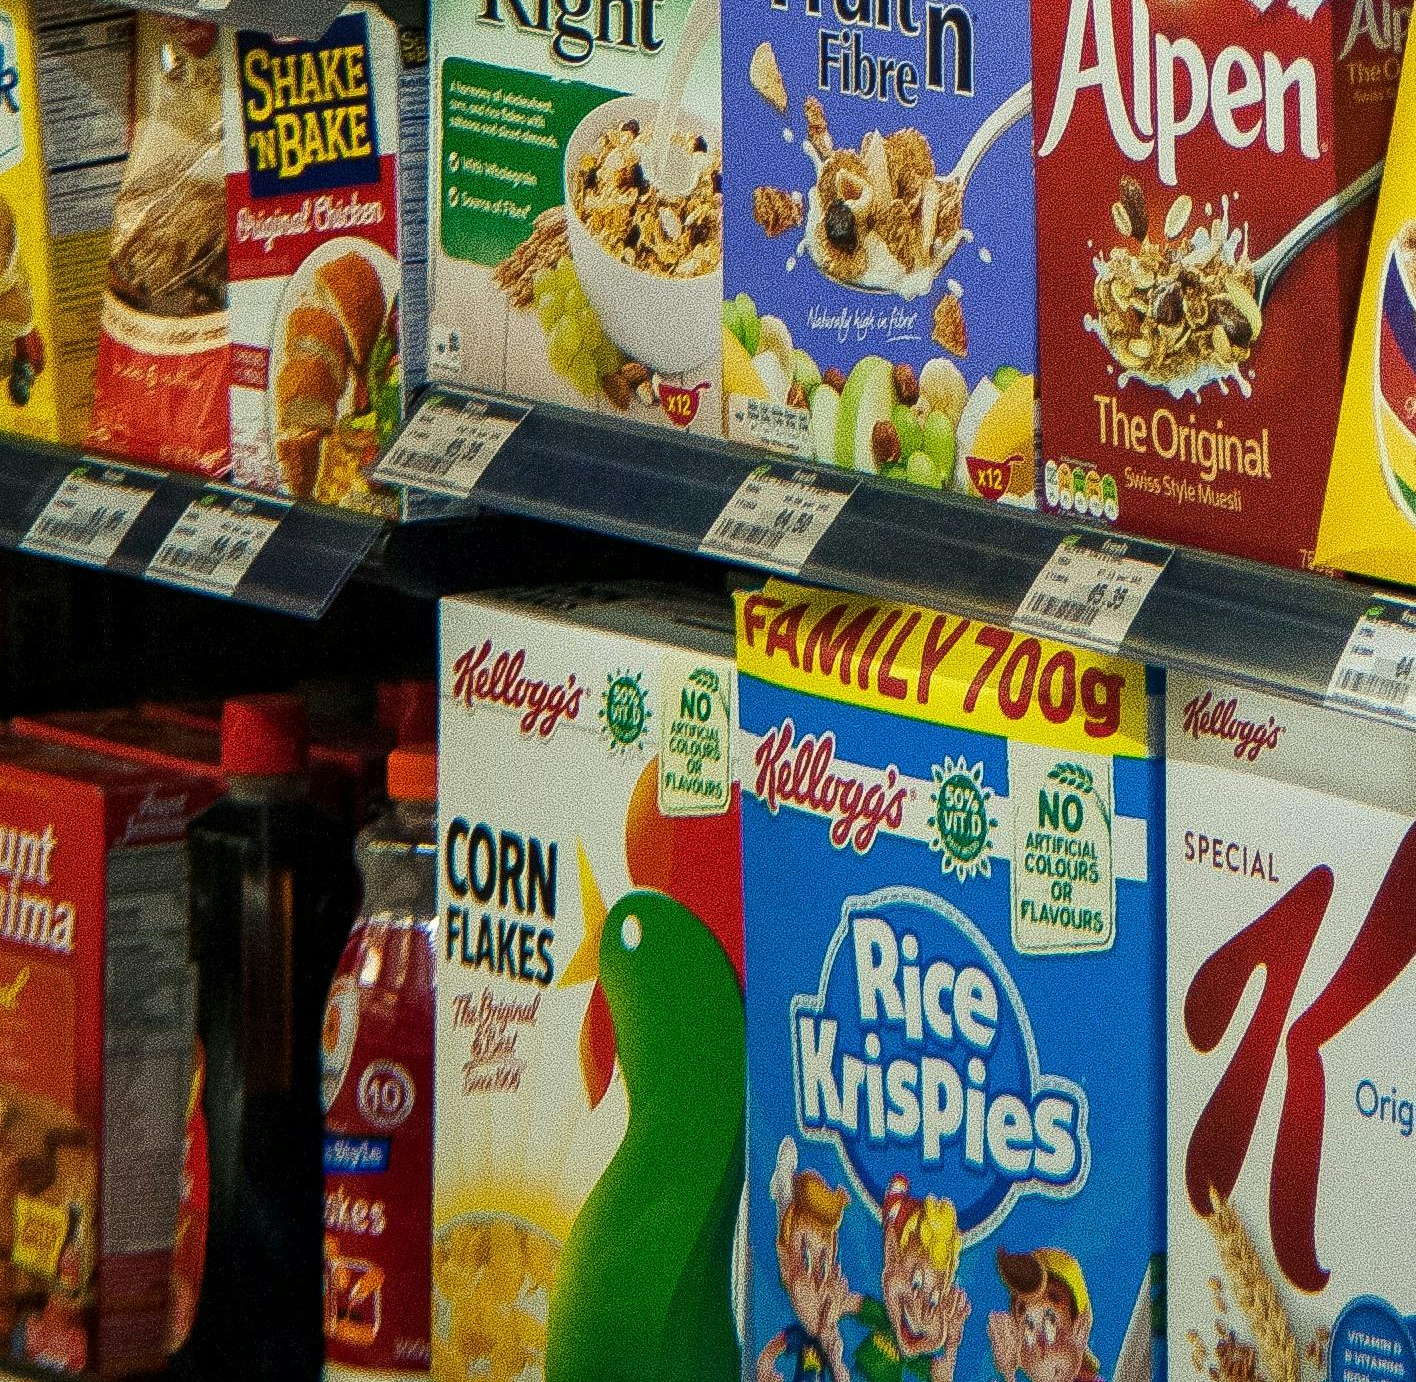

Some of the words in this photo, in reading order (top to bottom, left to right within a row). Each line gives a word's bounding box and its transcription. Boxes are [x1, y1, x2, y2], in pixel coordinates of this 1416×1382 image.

[243, 44, 371, 125] SHAKE
[816, 30, 920, 106] Fibre
[275, 103, 374, 180] BAKE
[235, 197, 312, 254] Original
[313, 190, 386, 233] Chicken
[1092, 393, 1149, 455] The
[1151, 407, 1274, 484] Original
[1122, 465, 1162, 496] Swiss
[1163, 468, 1196, 507] Style
[1196, 480, 1244, 513] Muesli
[453, 639, 585, 738] Kellogg's
[740, 591, 962, 706] FAMILY
[960, 623, 1128, 738] 700g
[670, 721, 720, 742] ARTIFICIAL
[680, 688, 713, 723] NO
[1182, 694, 1281, 763] Kellogg's
[668, 737, 721, 763] COLOURS
[686, 757, 702, 775] OR
[664, 771, 724, 800] FLAVOURS
[754, 720, 908, 854] Kellogg's
[1038, 787, 1084, 833] NO
[447, 817, 558, 920] CORN
[1024, 852, 1100, 884] COLOURS
[1025, 831, 1098, 861] ARTIFICIAL
[1184, 830, 1280, 884] SPECIAL
[1020, 898, 1105, 935] FLAVOURS
[1051, 880, 1073, 902] OR
[446, 911, 555, 989] FLAKES
[851, 916, 1001, 1049] Rice
[796, 1014, 1081, 1182] Krispies
